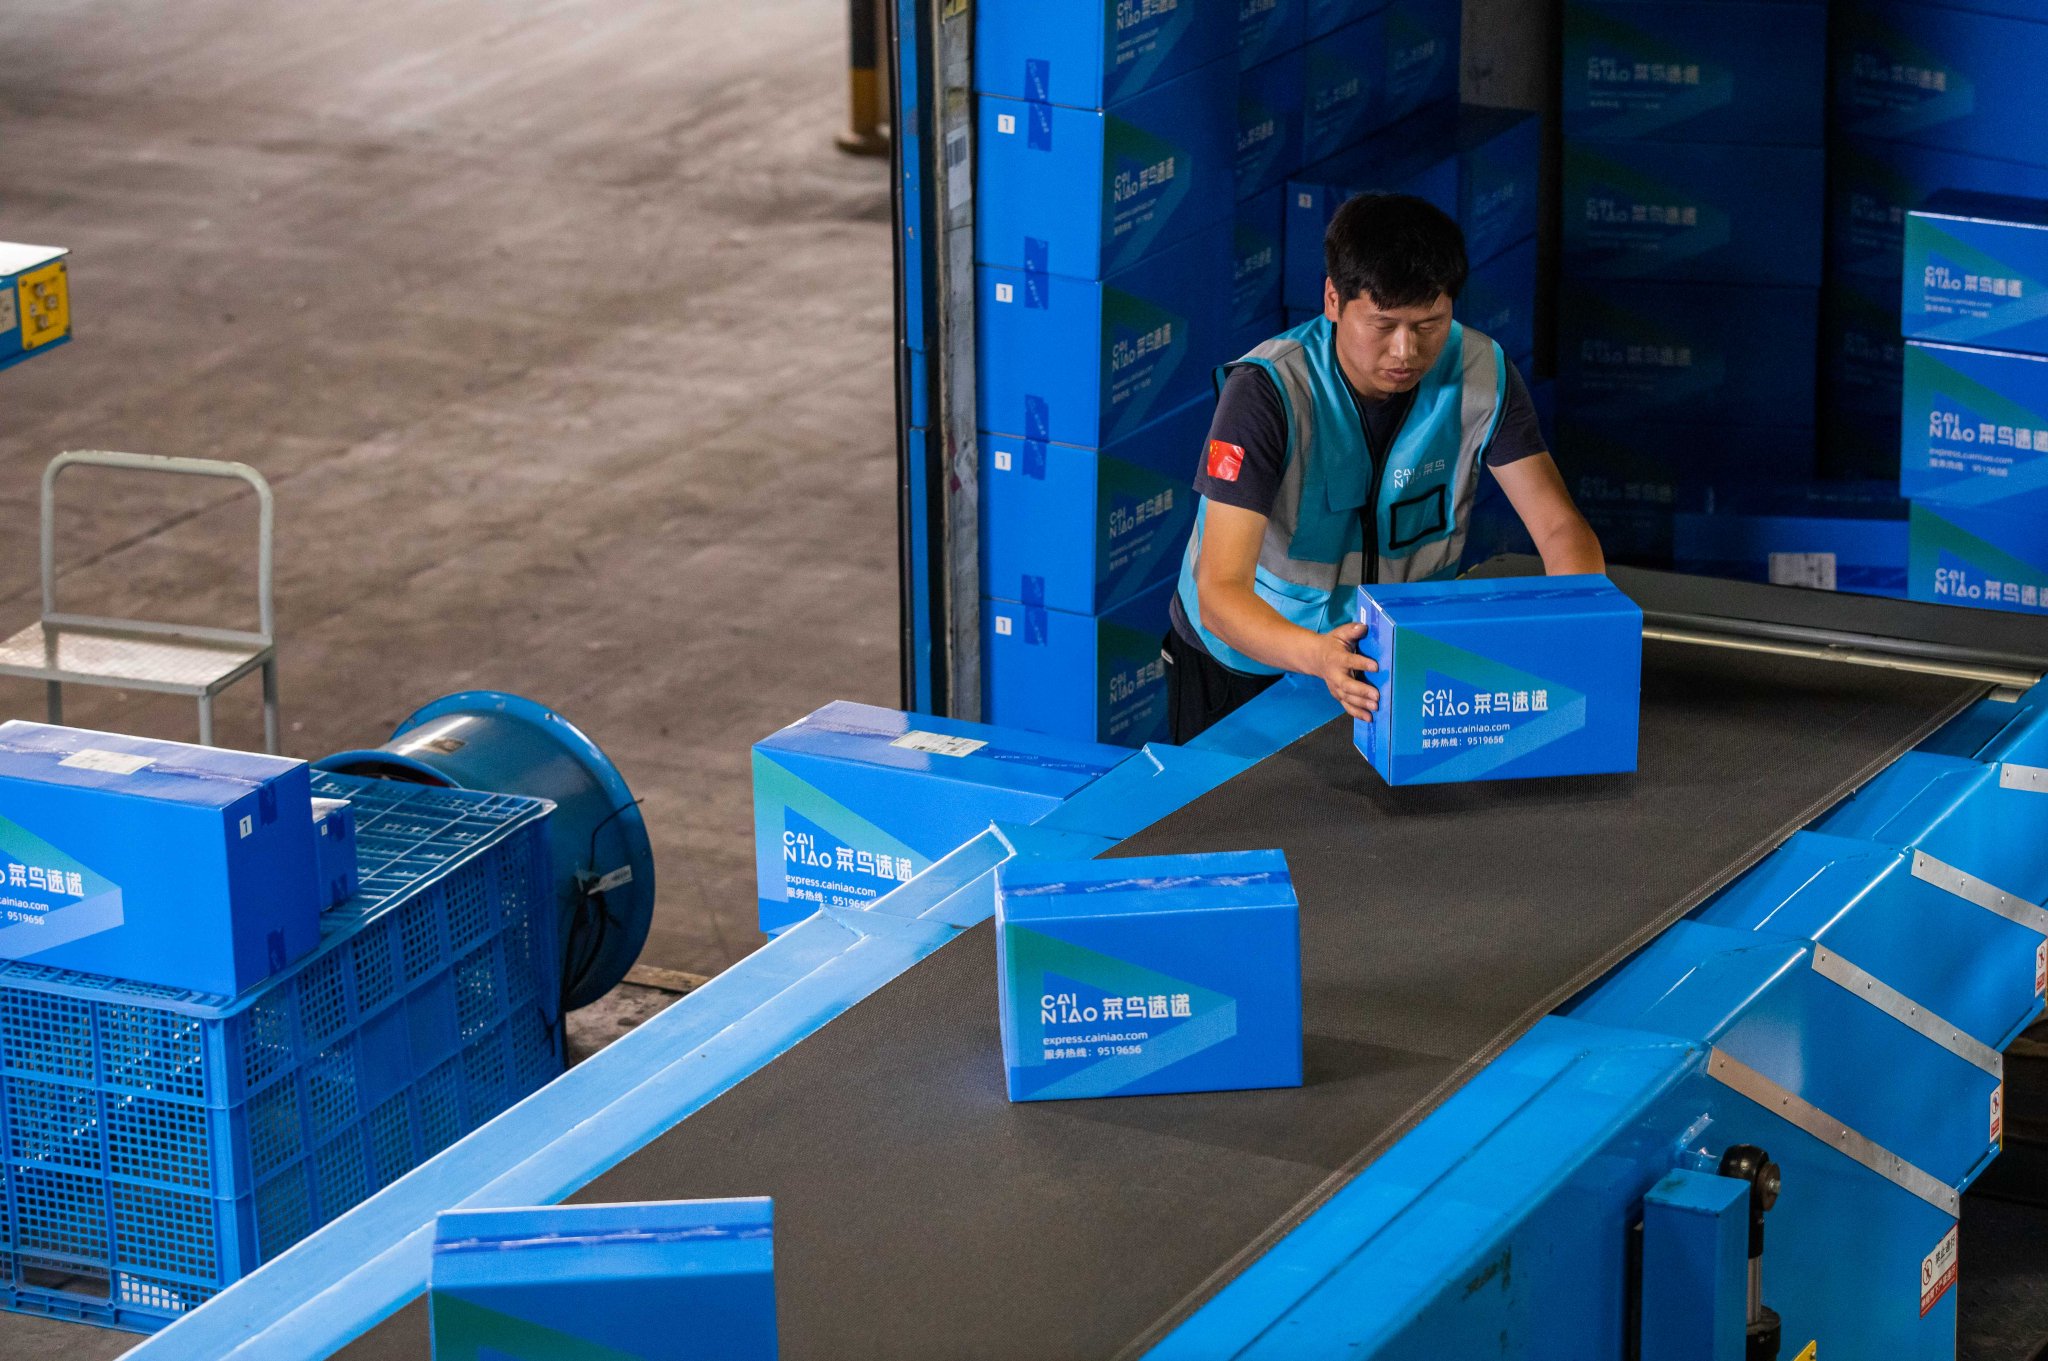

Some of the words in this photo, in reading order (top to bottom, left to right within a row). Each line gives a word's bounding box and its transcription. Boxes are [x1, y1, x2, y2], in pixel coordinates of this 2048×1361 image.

[1422, 688, 1453, 704] CAI
[1422, 699, 1470, 718] NIAO
[1474, 689, 1549, 715] 菜鸟速递
[1422, 722, 1510, 737] express.cainiao.com
[782, 830, 815, 850] CAI
[783, 844, 833, 868] NIAO
[835, 846, 913, 881] 菜鸟速递
[8, 862, 85, 897] 菜鸟速递
[785, 874, 877, 898] express.cainiao.com
[1040, 992, 1077, 1009] CAI
[1040, 1003, 1098, 1025] NIAO
[1102, 993, 1192, 1021] 菜鸟速递
[1042, 1031, 1149, 1046] express.cainiao.com
